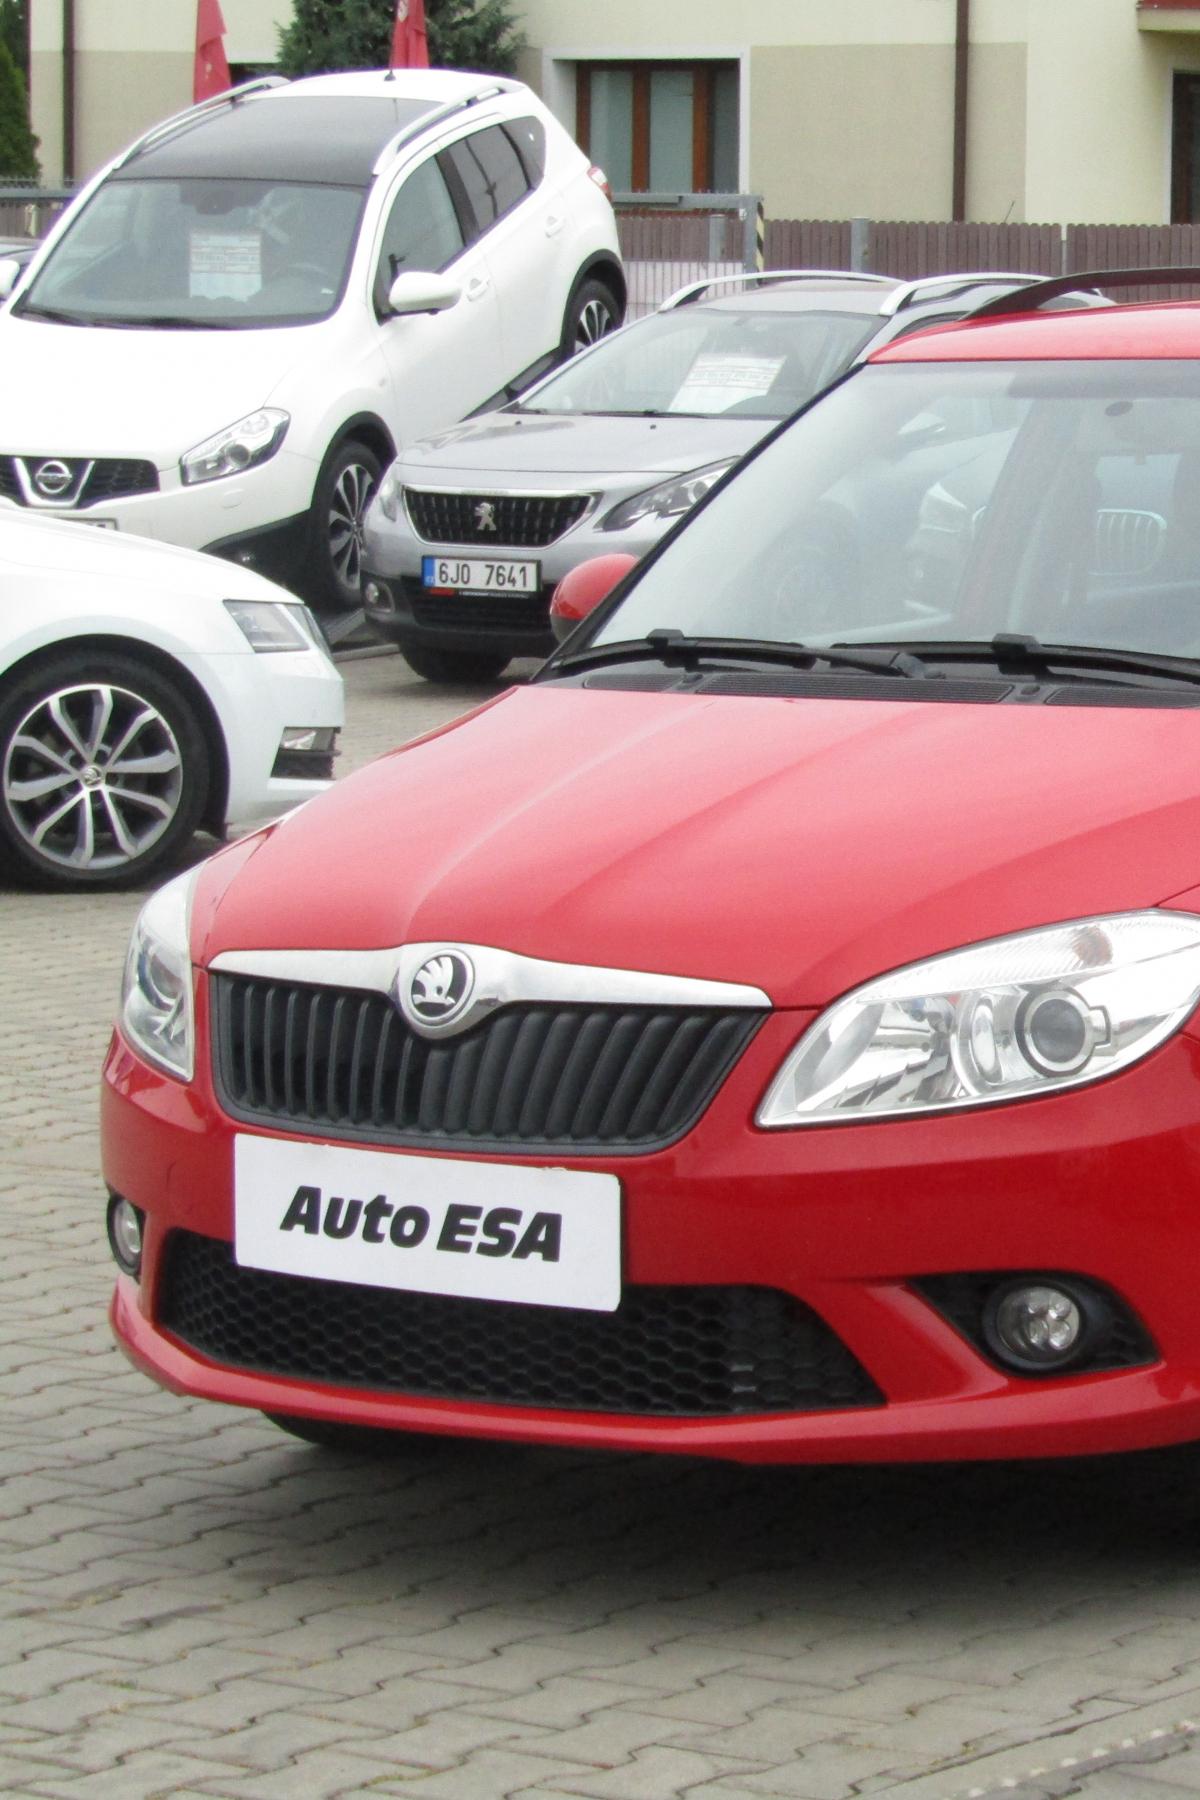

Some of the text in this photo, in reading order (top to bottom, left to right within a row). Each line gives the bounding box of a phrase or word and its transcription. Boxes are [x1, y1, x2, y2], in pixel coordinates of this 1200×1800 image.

[485, 564, 527, 588] 7641
[279, 1185, 562, 1263] Auto ESA
